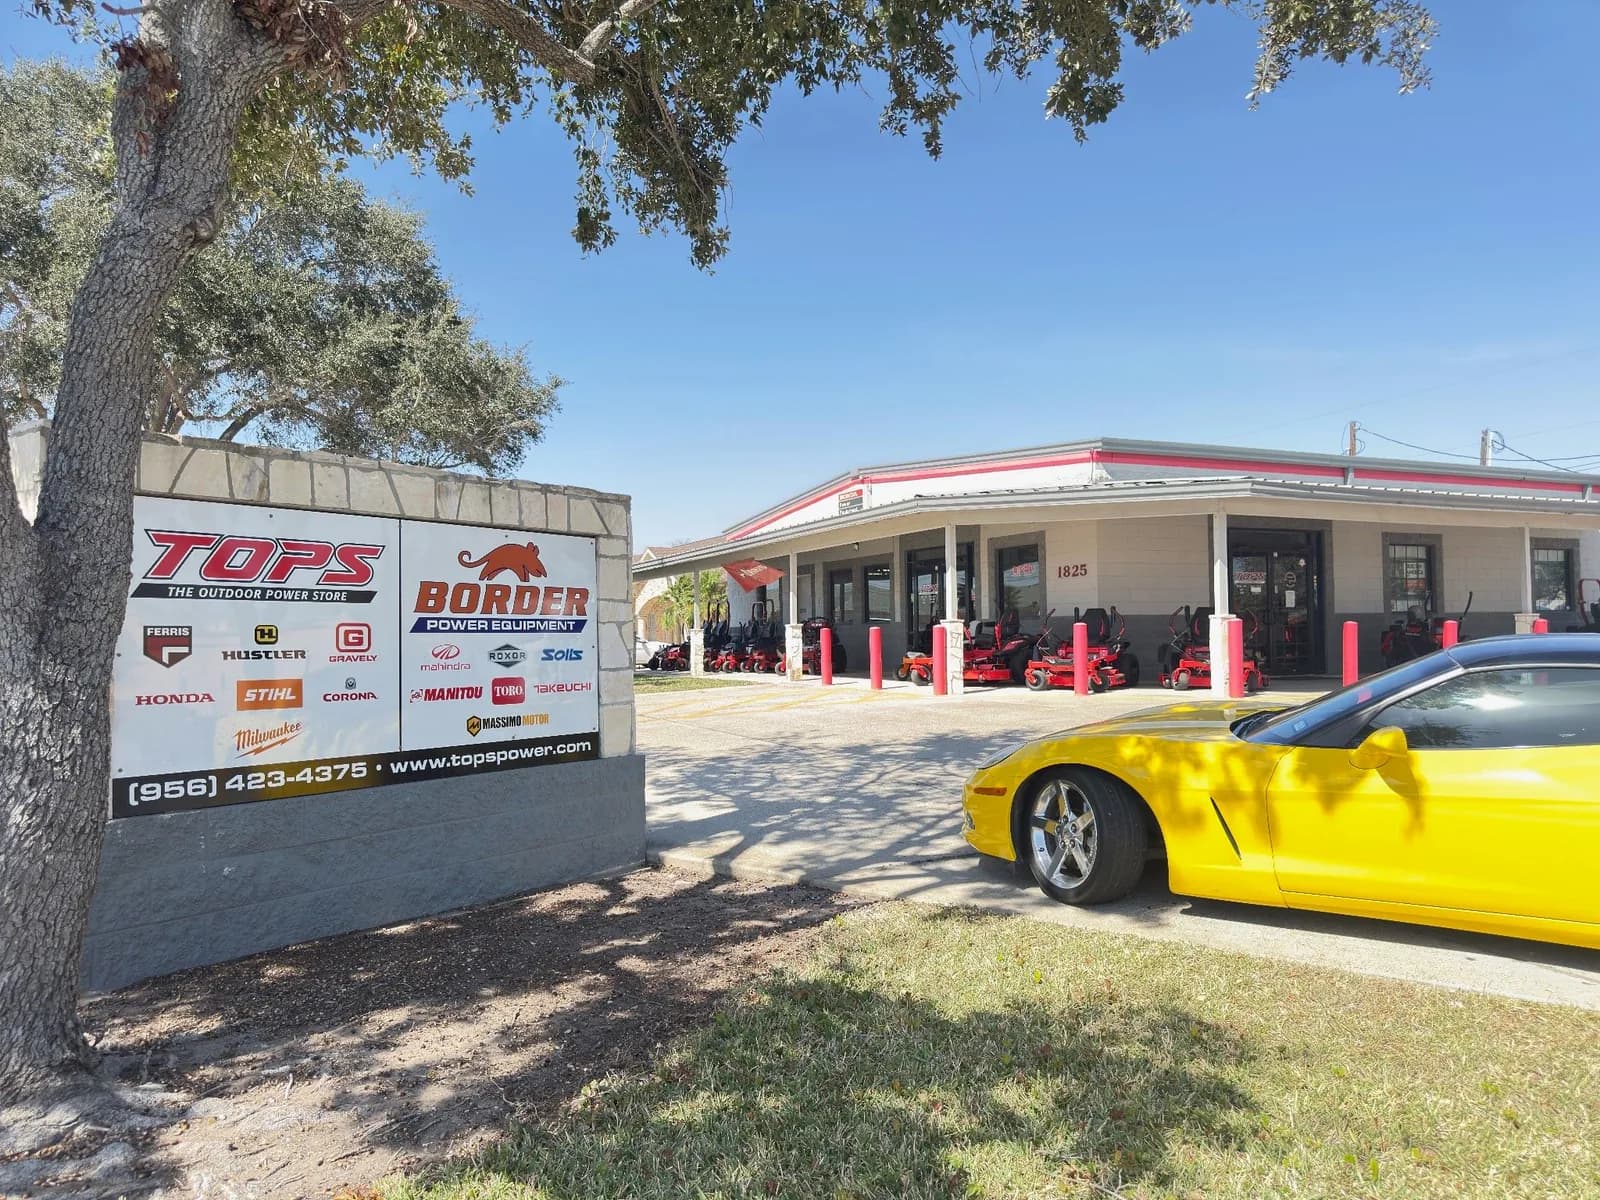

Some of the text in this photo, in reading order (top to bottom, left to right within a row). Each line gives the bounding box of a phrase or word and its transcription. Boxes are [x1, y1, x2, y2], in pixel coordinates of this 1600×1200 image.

[142, 528, 386, 587] TOPS
[1057, 563, 1088, 579] 1825
[167, 586, 348, 602] THE OUTDOOR POWER STORE
[413, 581, 588, 616] BORDER
[146, 627, 190, 637] FERRIS
[426, 619, 576, 632] POWER EQUIPMENT
[221, 650, 308, 661] HUSTLER
[328, 655, 378, 663] GRAVELY
[489, 652, 526, 661] ROXOR
[541, 648, 583, 662] Solis
[420, 662, 471, 671] mahindra
[244, 688, 297, 702] STIHL
[424, 686, 483, 702] MANITOU
[533, 682, 592, 694] TAKEUCHI
[135, 693, 216, 706] HONDA
[322, 692, 378, 702] CORONA
[482, 713, 550, 730] MASSIMO MOTOR
[233, 721, 303, 751] Milwaukee
[128, 741, 591, 807] (956) 423-4375 www.topspower.com
